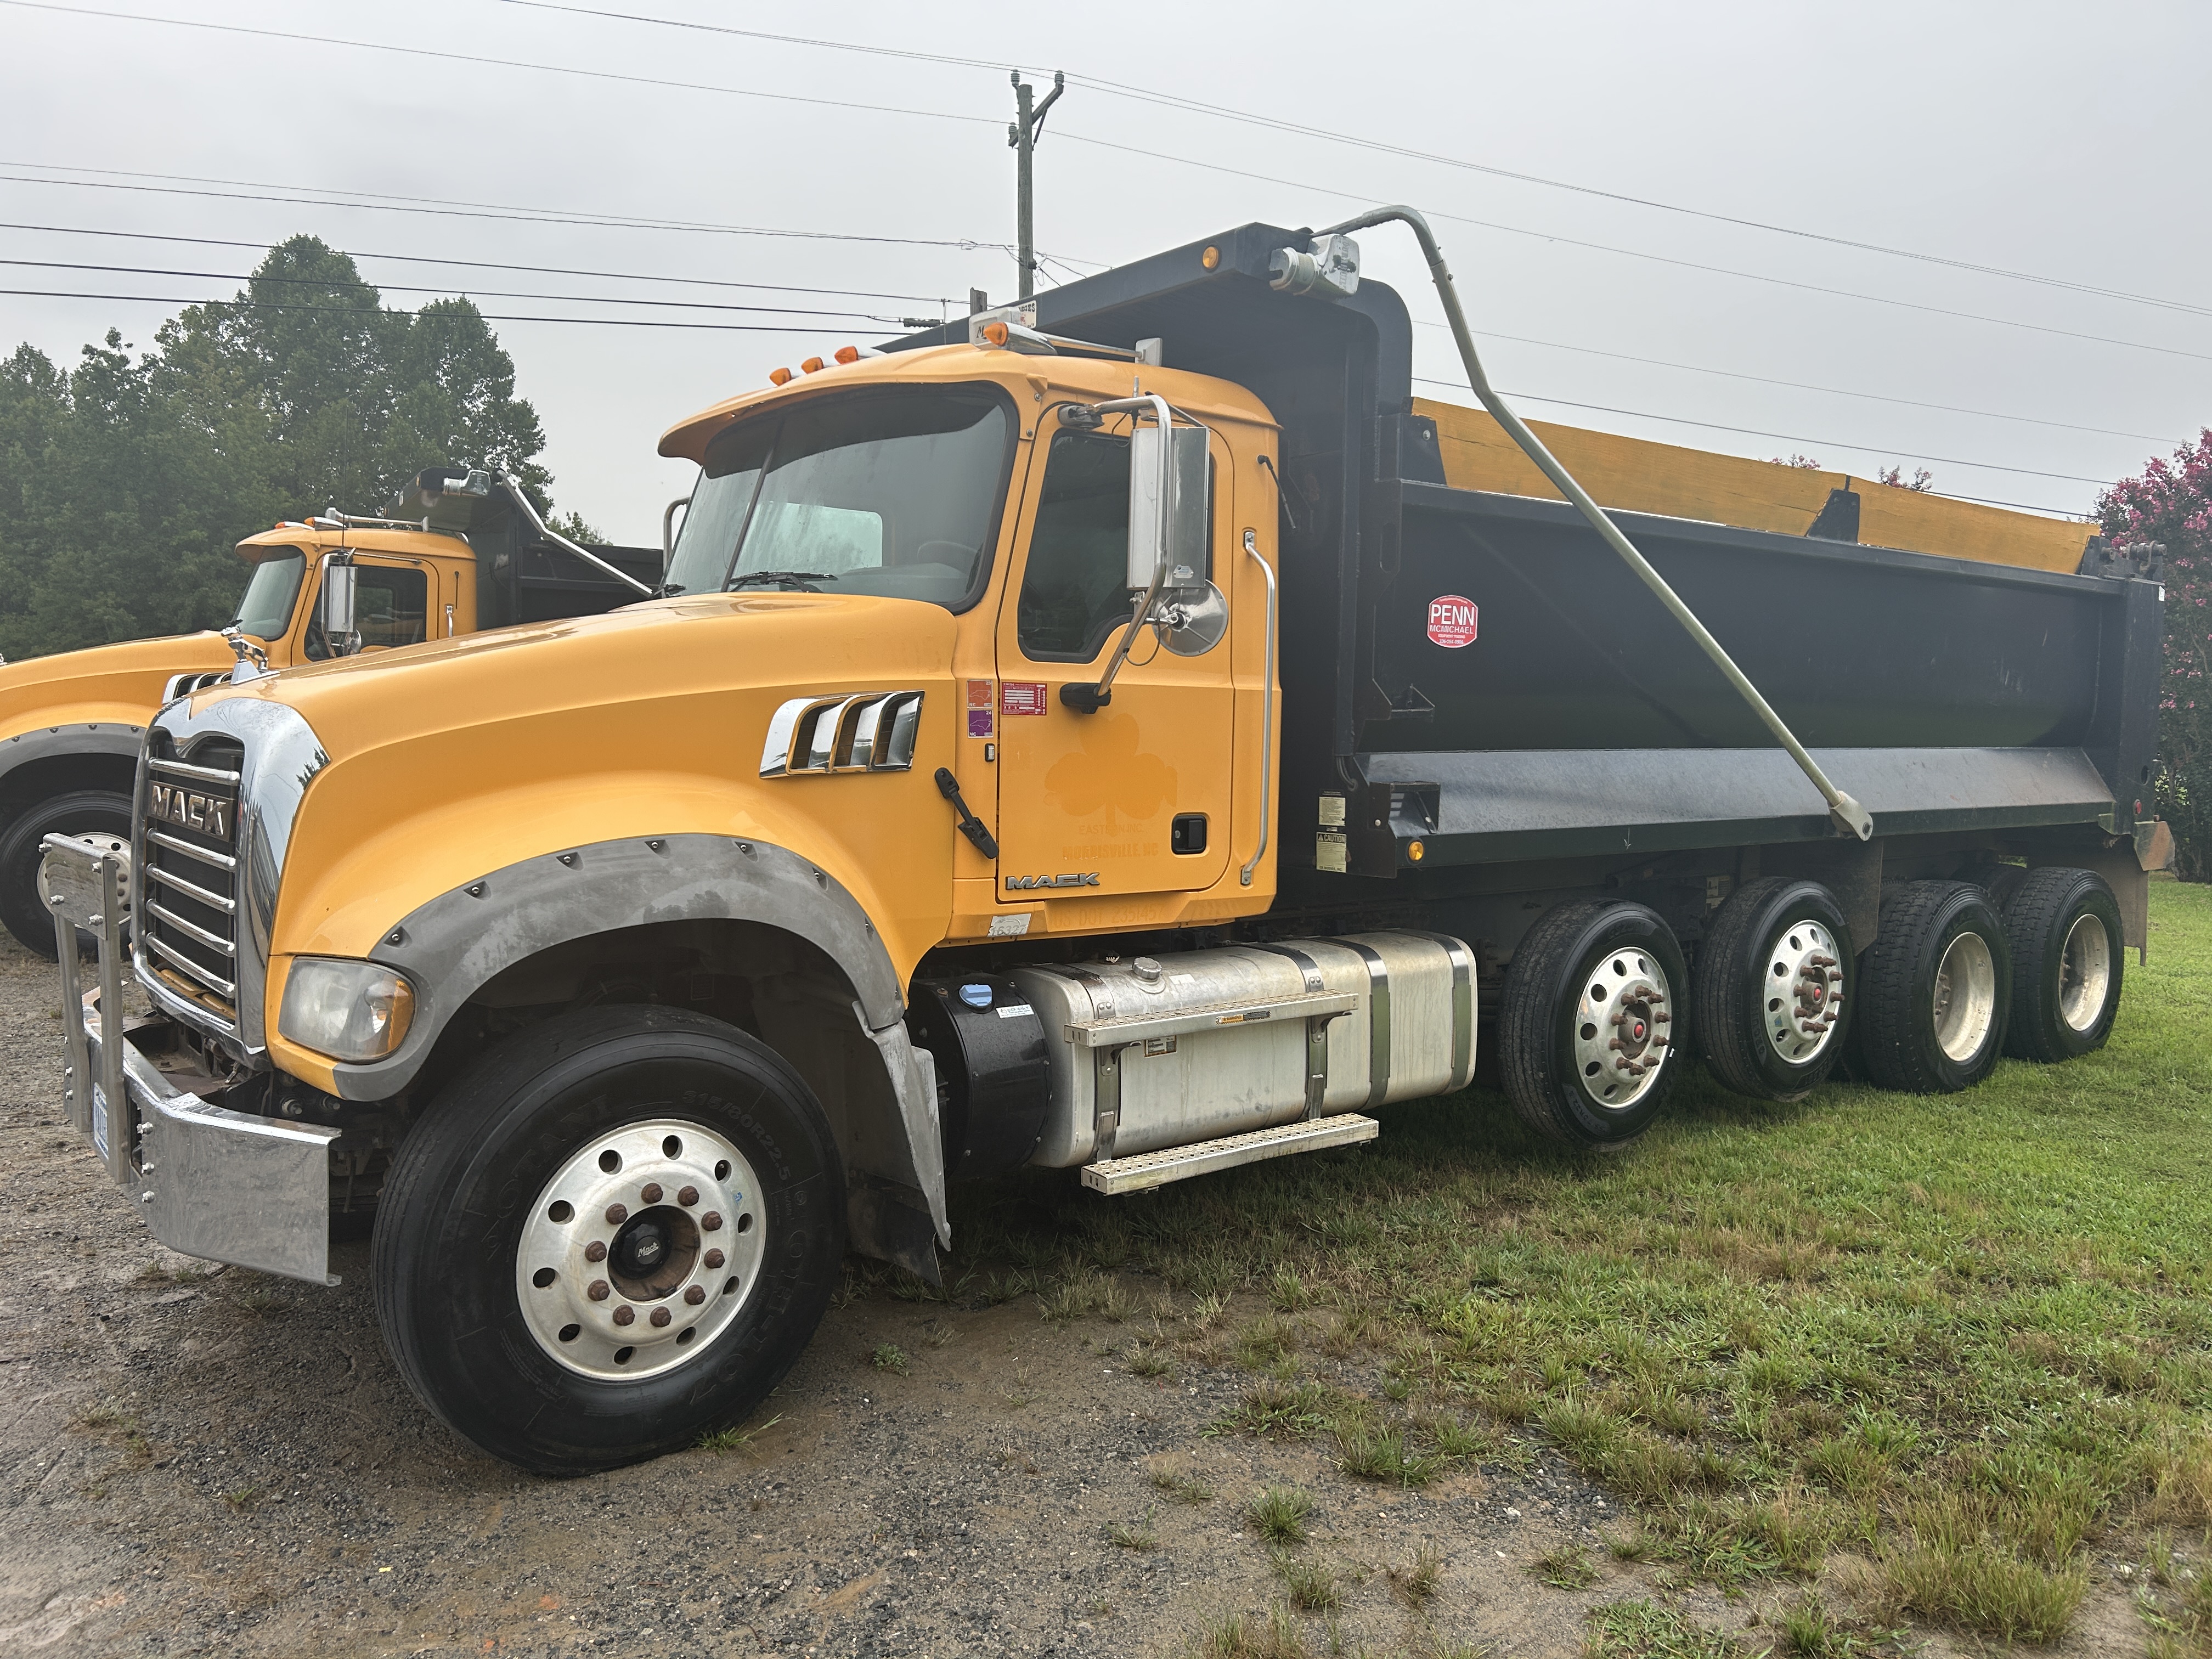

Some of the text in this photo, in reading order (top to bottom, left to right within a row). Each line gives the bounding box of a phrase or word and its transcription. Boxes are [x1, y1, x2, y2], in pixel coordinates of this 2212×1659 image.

[1019, 303, 1035, 313] DIES
[1430, 604, 1475, 626] PENN
[1430, 625, 1474, 634] MCMICHAEL
[151, 785, 227, 836] MACK
[1324, 834, 1346, 843] CAUTION
[1006, 872, 1101, 890] MACK
[991, 924, 1027, 936] 16327
[682, 1090, 792, 1181] 315/80R22.5
[637, 1242, 659, 1257] Mack
